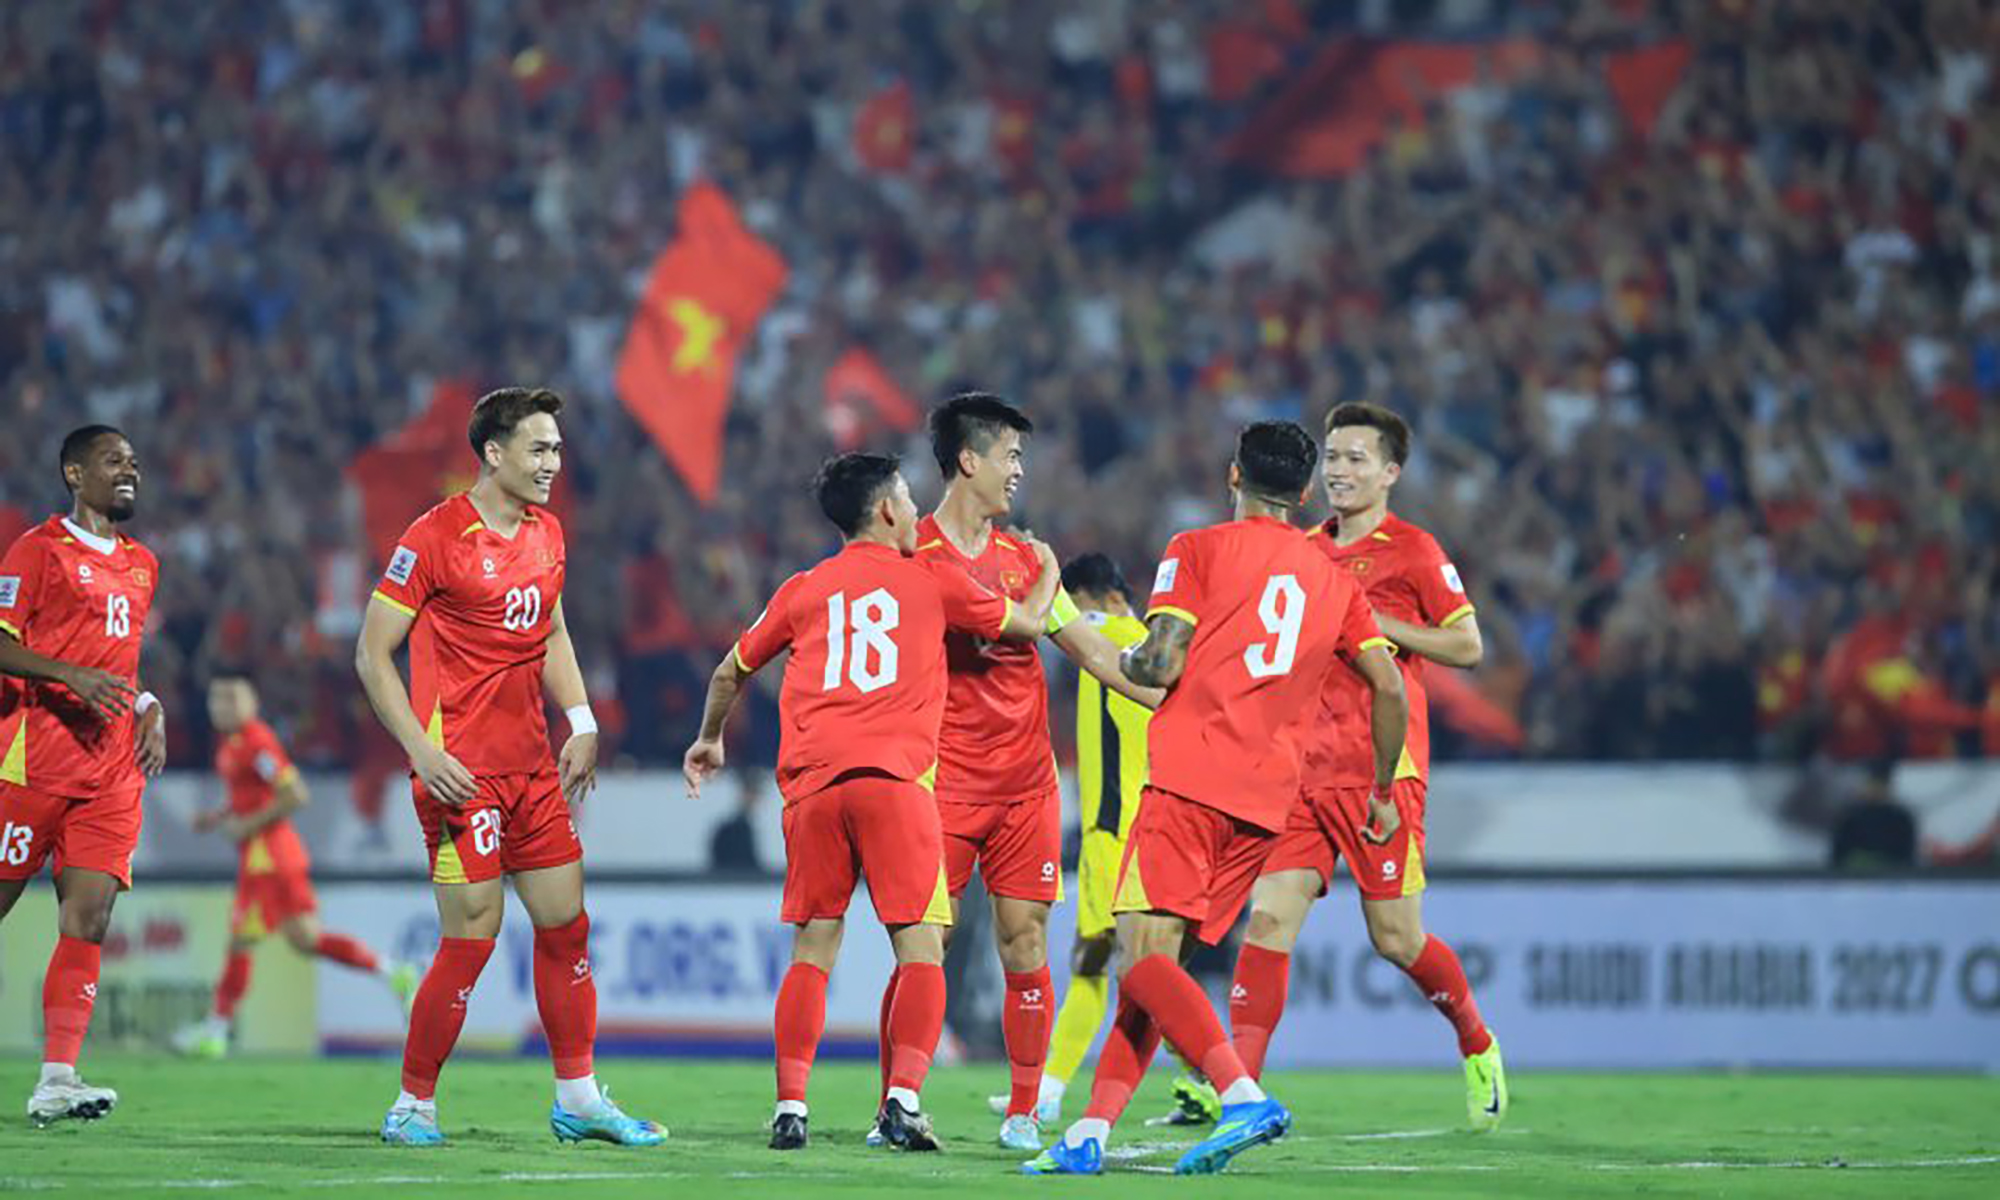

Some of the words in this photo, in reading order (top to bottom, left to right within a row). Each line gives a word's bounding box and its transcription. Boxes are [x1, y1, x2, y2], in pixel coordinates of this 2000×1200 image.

[105, 593, 130, 638] 13
[504, 584, 541, 630] 20
[1243, 574, 1306, 679] 9
[823, 588, 899, 693] 18
[0, 821, 34, 866] 13
[1524, 942, 1648, 1012] SAUDI
[1665, 942, 1815, 1012] ARABIA
[1830, 942, 1941, 1014] 2027
